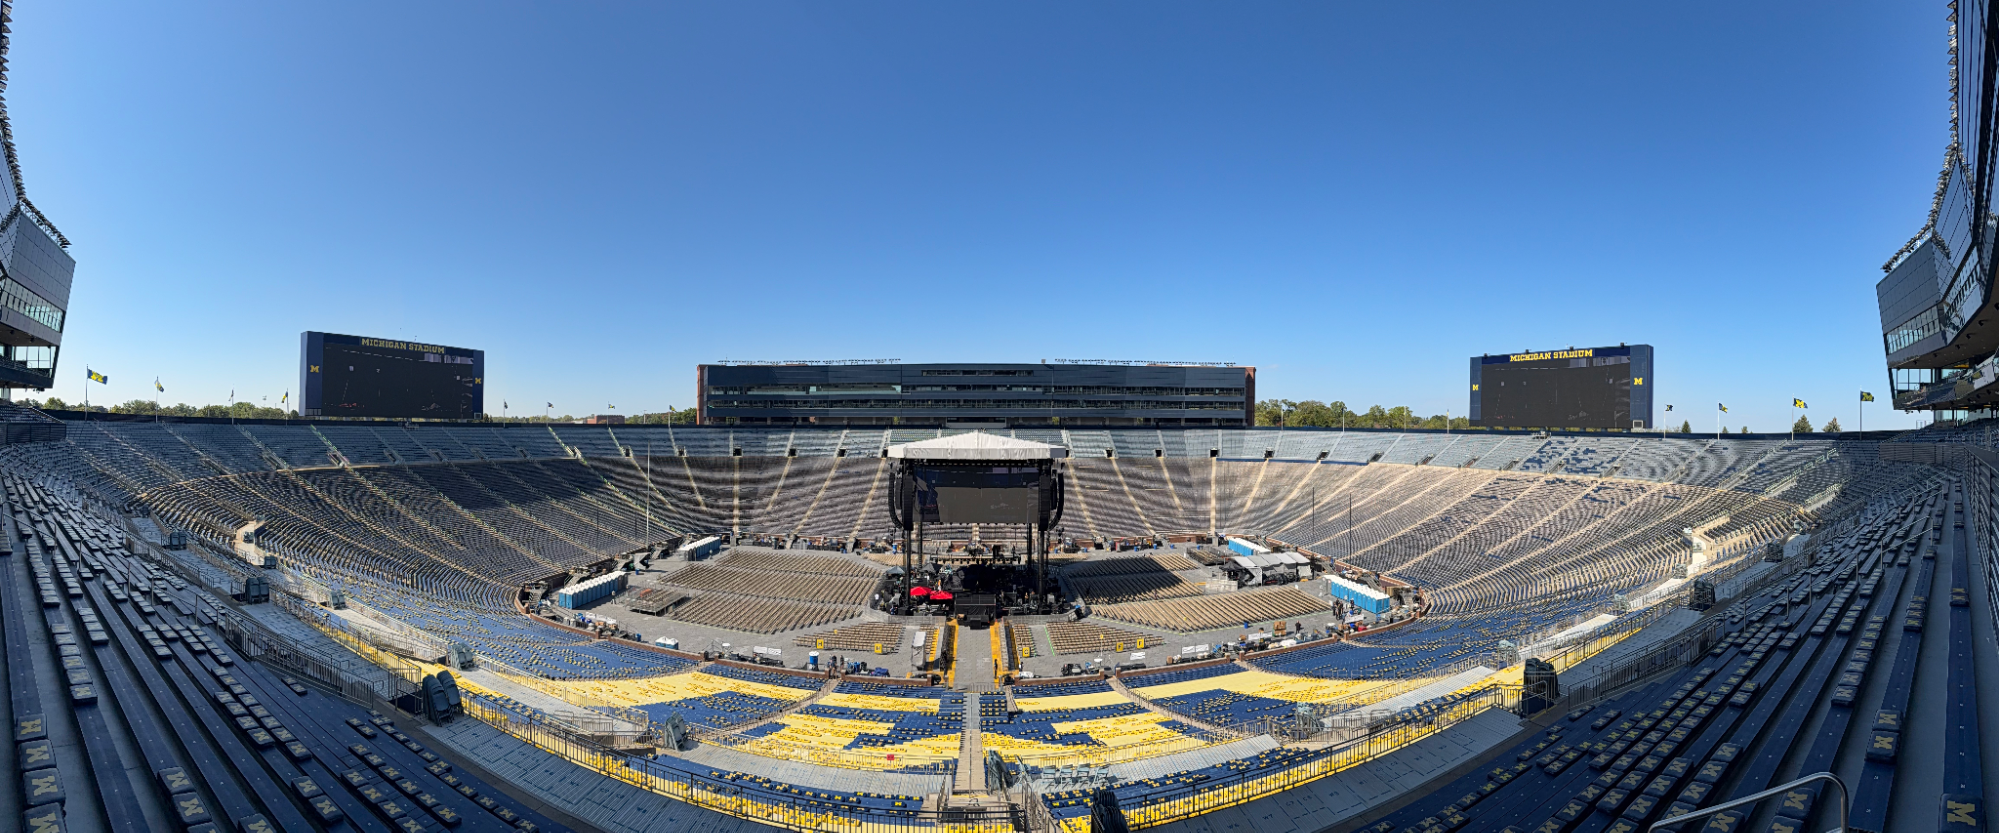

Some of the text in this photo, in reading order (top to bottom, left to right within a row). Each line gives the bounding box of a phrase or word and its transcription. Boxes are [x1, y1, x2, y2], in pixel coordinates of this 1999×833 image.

[361, 337, 445, 354] MICHIGAN STADIUM
[1510, 349, 1593, 362] MICHIGAN STADIUM
[309, 365, 319, 373] M
[475, 377, 482, 385] M
[1633, 377, 1643, 386] M
[1795, 398, 1805, 408] M
[1861, 392, 1872, 401] M
[1879, 713, 1897, 725] M
[21, 719, 41, 734] M
[1874, 736, 1893, 749] M
[26, 746, 49, 762] M
[1669, 761, 1686, 772] M
[1703, 764, 1721, 776] M
[32, 776, 58, 796] M
[167, 772, 189, 787] M
[299, 780, 317, 792] M
[1624, 774, 1641, 785] M
[1652, 778, 1670, 791] M
[364, 788, 381, 799] M
[1581, 786, 1599, 798] M
[1604, 792, 1622, 804] M
[1684, 785, 1705, 798] M
[180, 798, 204, 816] M
[317, 800, 337, 814] M
[1631, 799, 1651, 813] M
[1784, 792, 1807, 809] M
[384, 802, 401, 814] M
[439, 808, 456, 819] M
[1563, 803, 1581, 816] M
[1947, 801, 1976, 826] M
[30, 813, 59, 833] M
[248, 820, 273, 833] M
[1710, 813, 1735, 832] M
